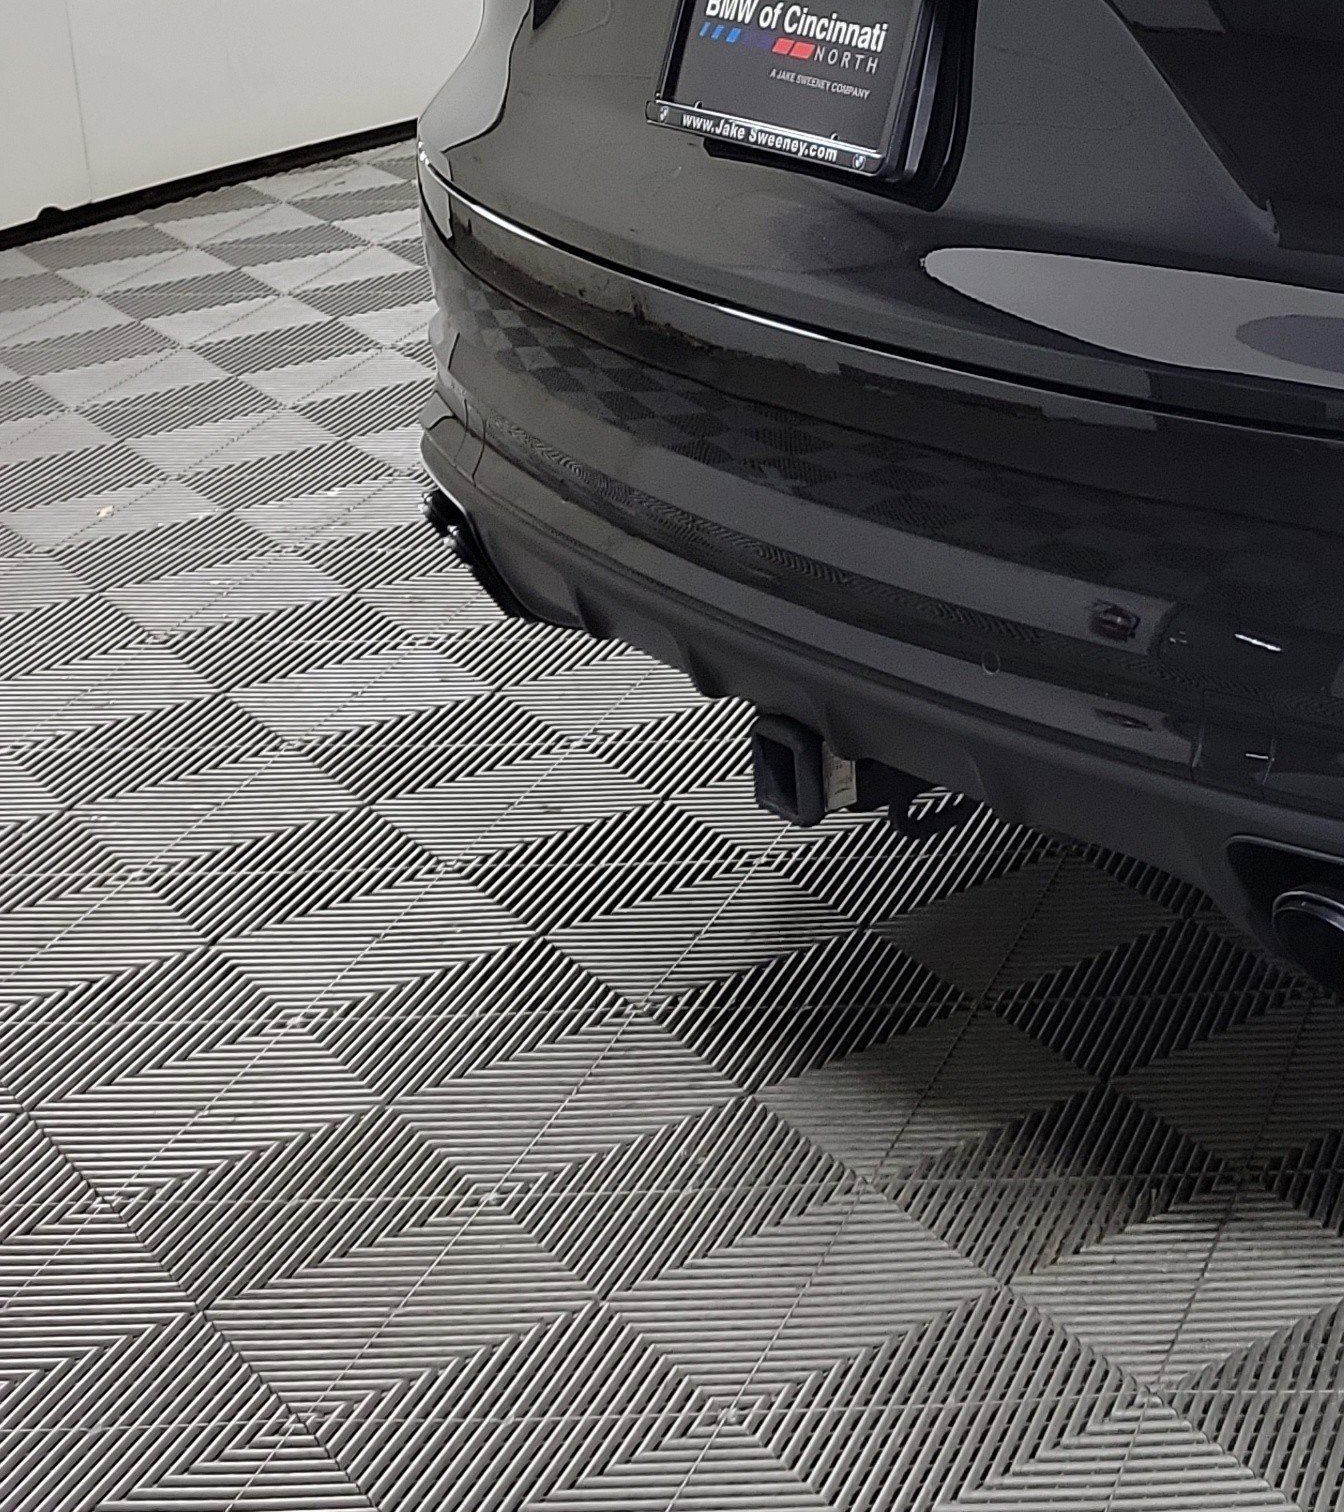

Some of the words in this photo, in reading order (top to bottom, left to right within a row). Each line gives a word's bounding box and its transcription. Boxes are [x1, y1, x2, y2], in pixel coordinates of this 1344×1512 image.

[759, 2, 785, 29] of
[784, 4, 888, 53] Cincinnati
[814, 45, 879, 75] NORTH
[770, 69, 776, 78] A
[777, 70, 796, 83] JAKE
[796, 74, 831, 92] SWEENEY
[831, 82, 871, 100] COMPANY
[682, 112, 746, 141] www.Jake
[748, 124, 838, 163] Sweeney.com
